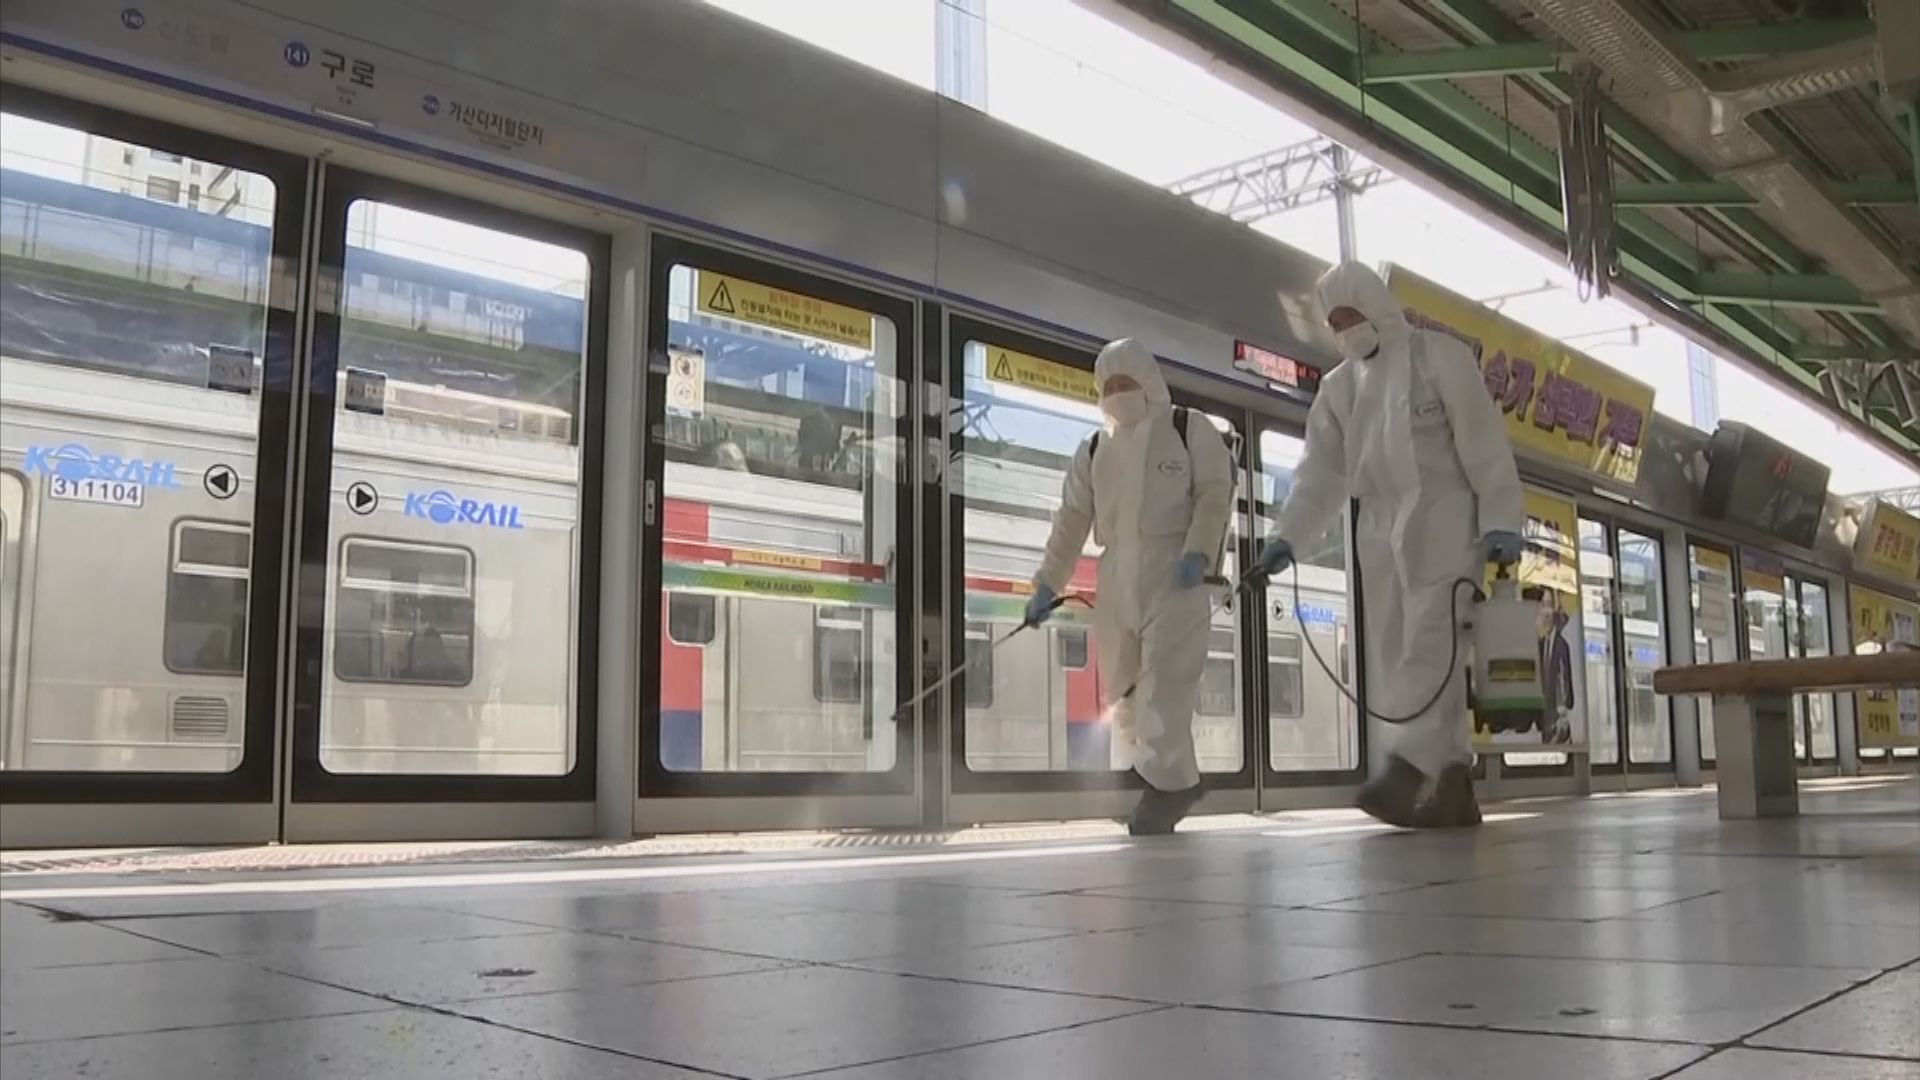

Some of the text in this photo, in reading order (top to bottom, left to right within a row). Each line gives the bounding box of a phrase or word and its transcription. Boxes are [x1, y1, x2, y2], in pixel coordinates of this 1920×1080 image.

[321, 49, 375, 88] 구로
[23, 443, 182, 491] KORAIL
[53, 477, 139, 503] 311104
[403, 490, 524, 529] KORAIL
